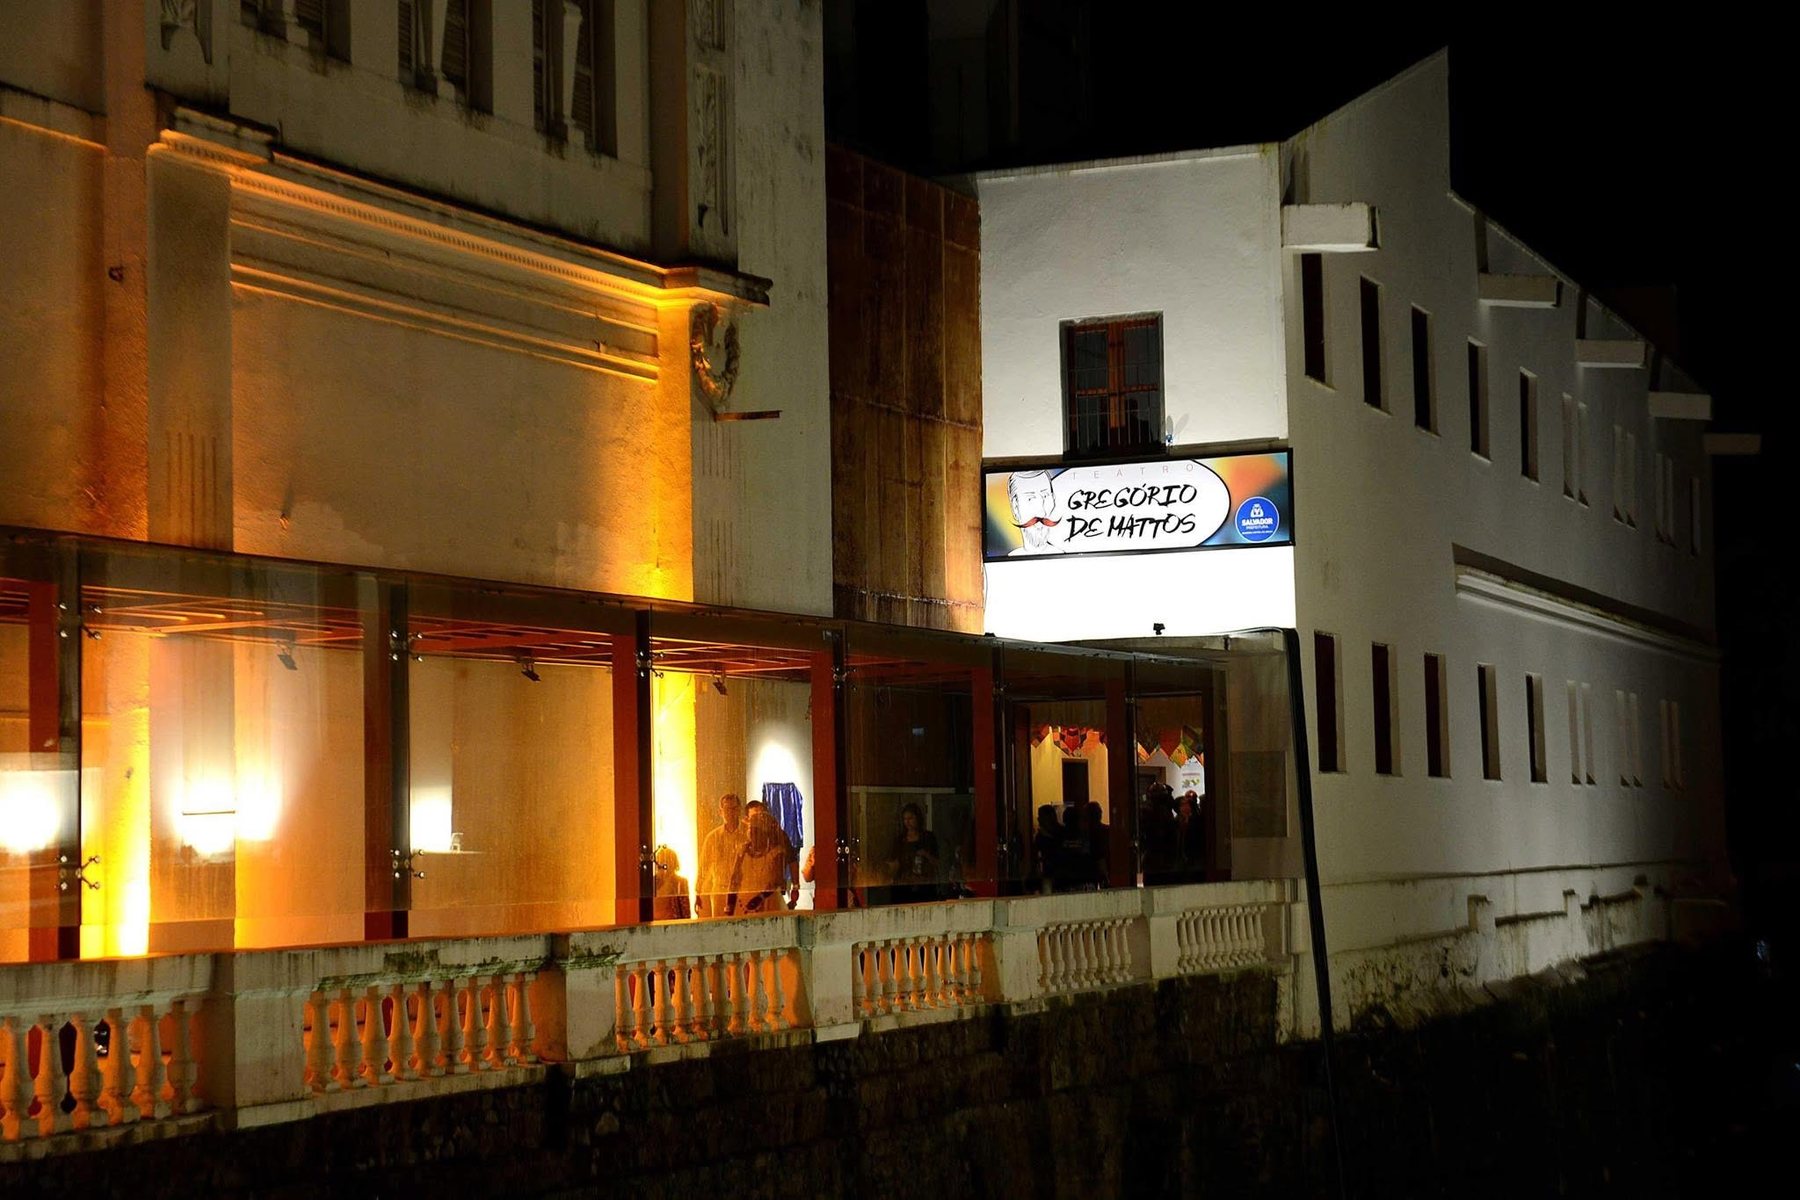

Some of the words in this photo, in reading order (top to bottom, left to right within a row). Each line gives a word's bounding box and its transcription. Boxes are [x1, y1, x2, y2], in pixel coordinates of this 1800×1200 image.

[1072, 463, 1194, 479] TEATRO
[1067, 483, 1198, 510] GREGÓRIO
[1064, 514, 1104, 542] DE
[1107, 513, 1196, 539] MATTOS
[1241, 517, 1274, 527] SALVADOR
